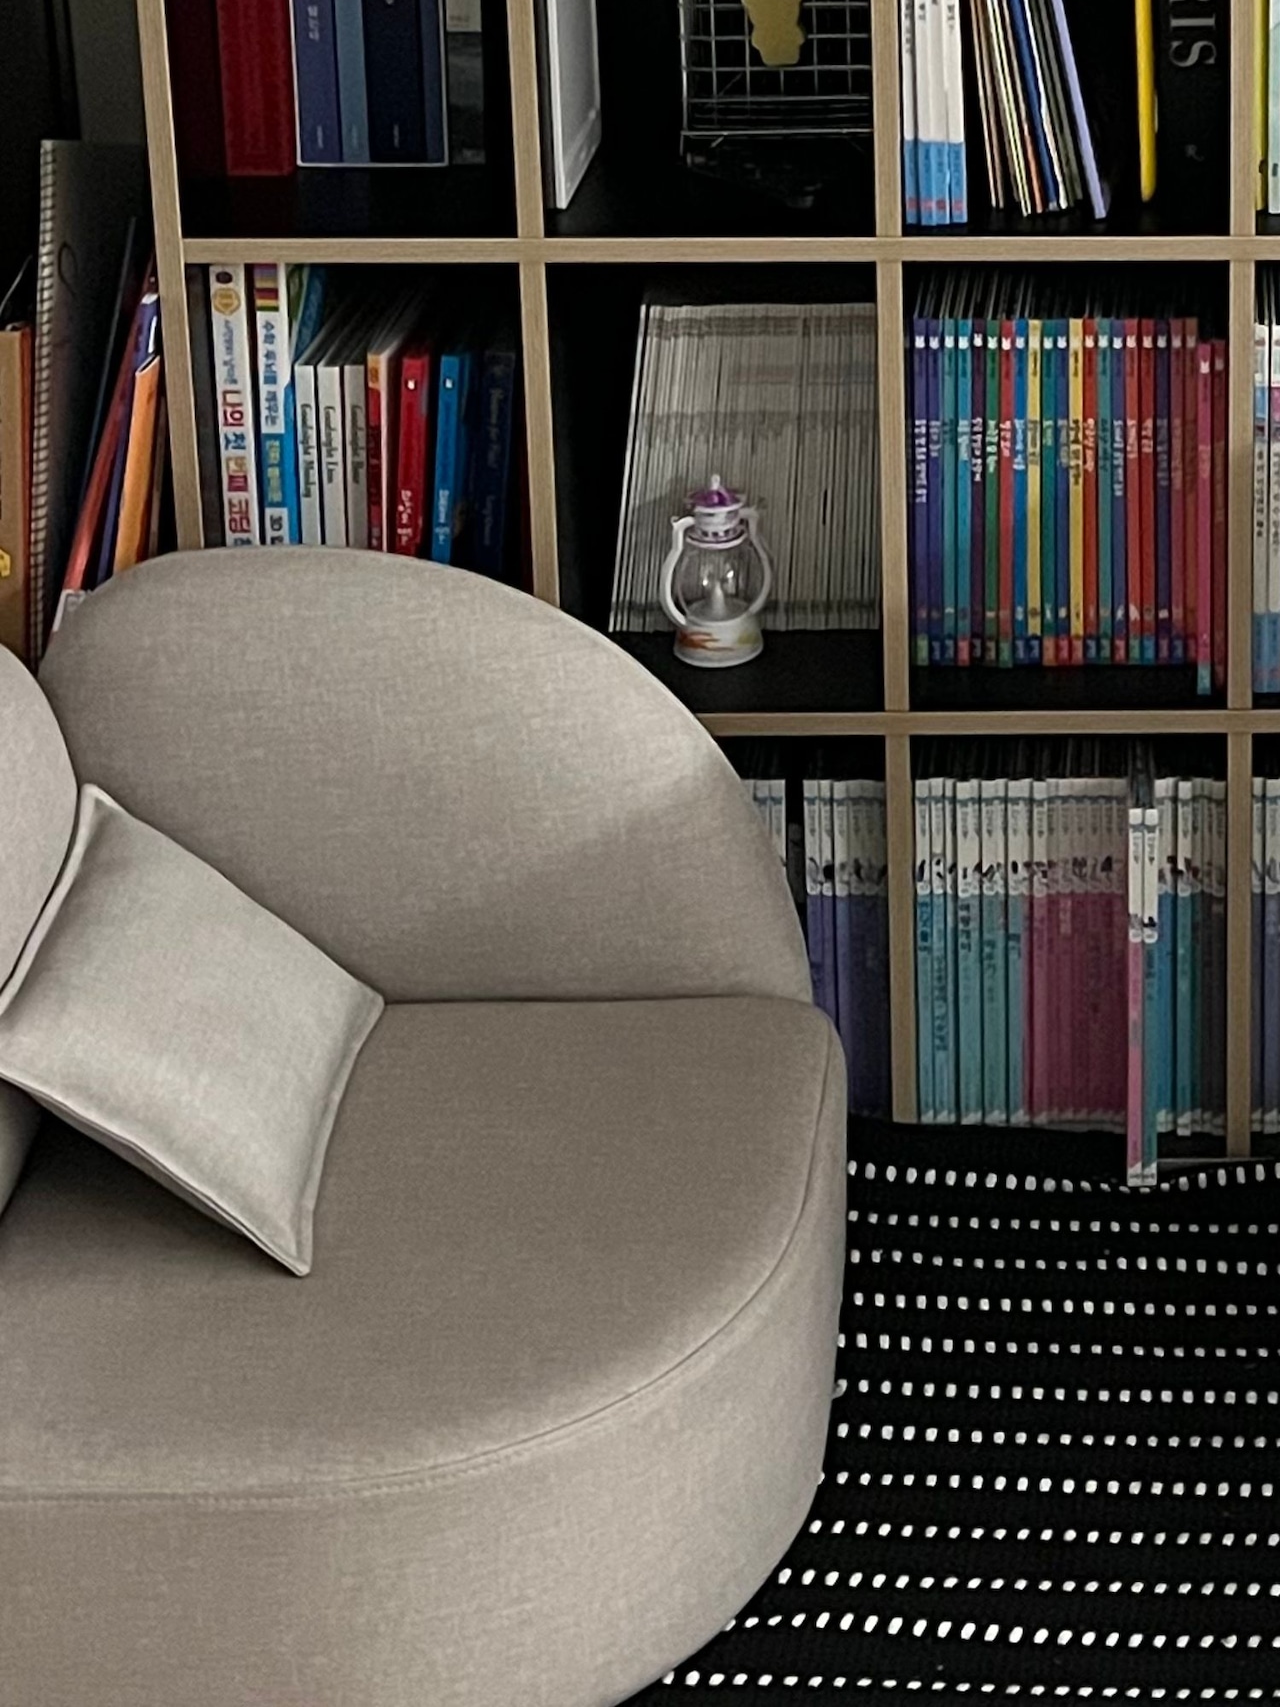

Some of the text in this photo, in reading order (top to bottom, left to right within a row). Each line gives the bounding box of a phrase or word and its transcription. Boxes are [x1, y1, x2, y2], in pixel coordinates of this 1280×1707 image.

[262, 320, 278, 345] 수학
[221, 390, 244, 427] 나의
[223, 433, 247, 451] 첫
[299, 403, 315, 455] Goodnight
[322, 406, 339, 484] Goodnight Lion
[350, 404, 364, 457] Goodnight
[228, 497, 251, 534] 코딩
